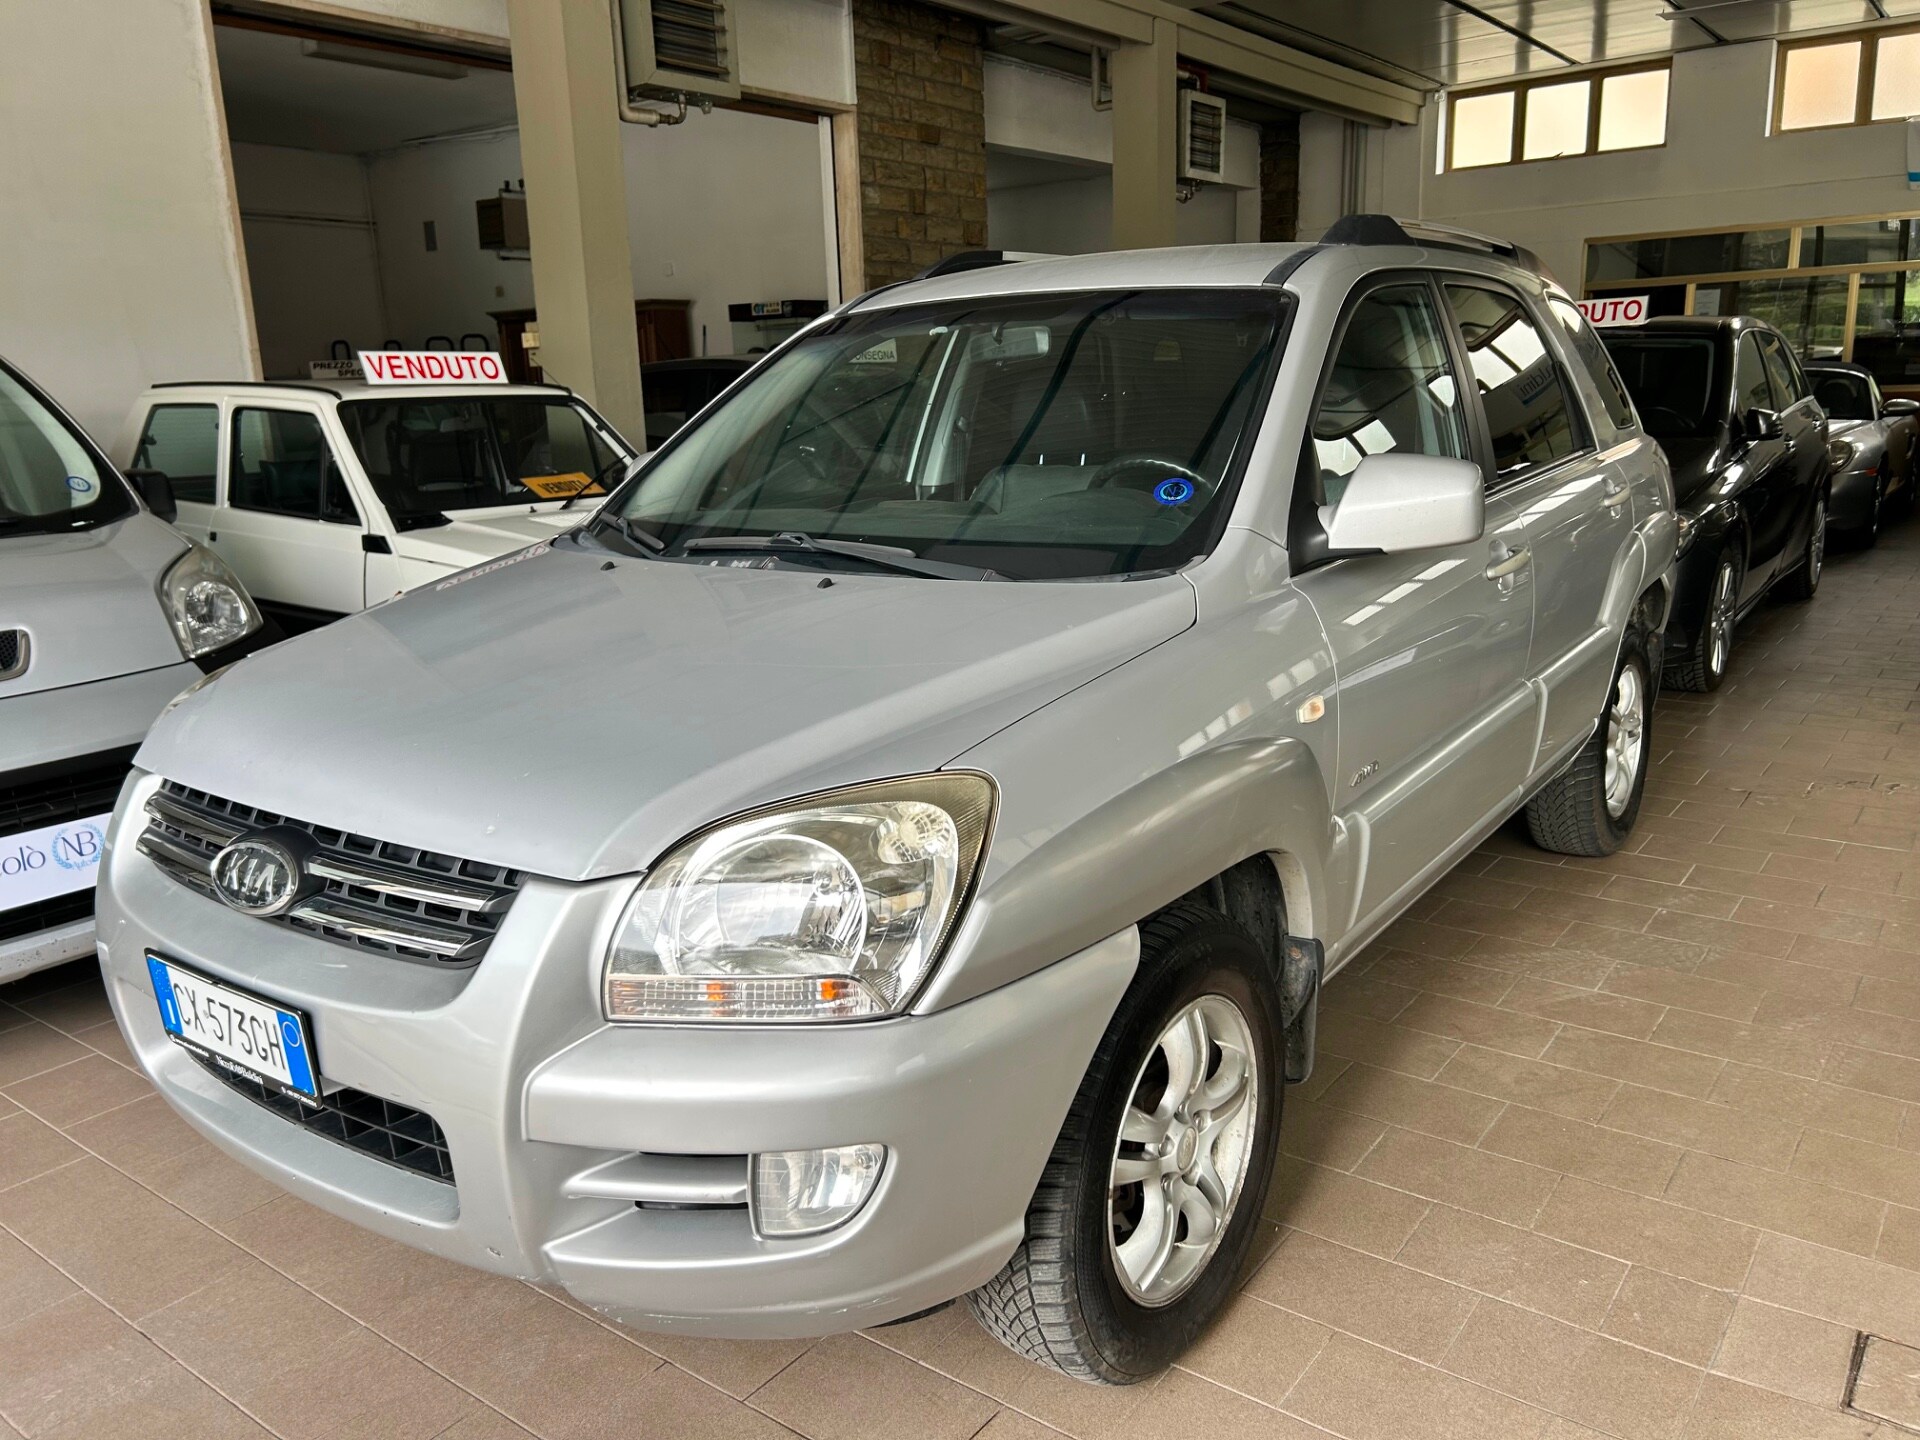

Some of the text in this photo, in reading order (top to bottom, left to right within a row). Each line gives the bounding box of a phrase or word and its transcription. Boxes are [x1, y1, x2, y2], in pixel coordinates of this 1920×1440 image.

[313, 361, 353, 370] PREZZO
[365, 355, 499, 379] VENDUTO
[0, 830, 97, 876] olò NB
